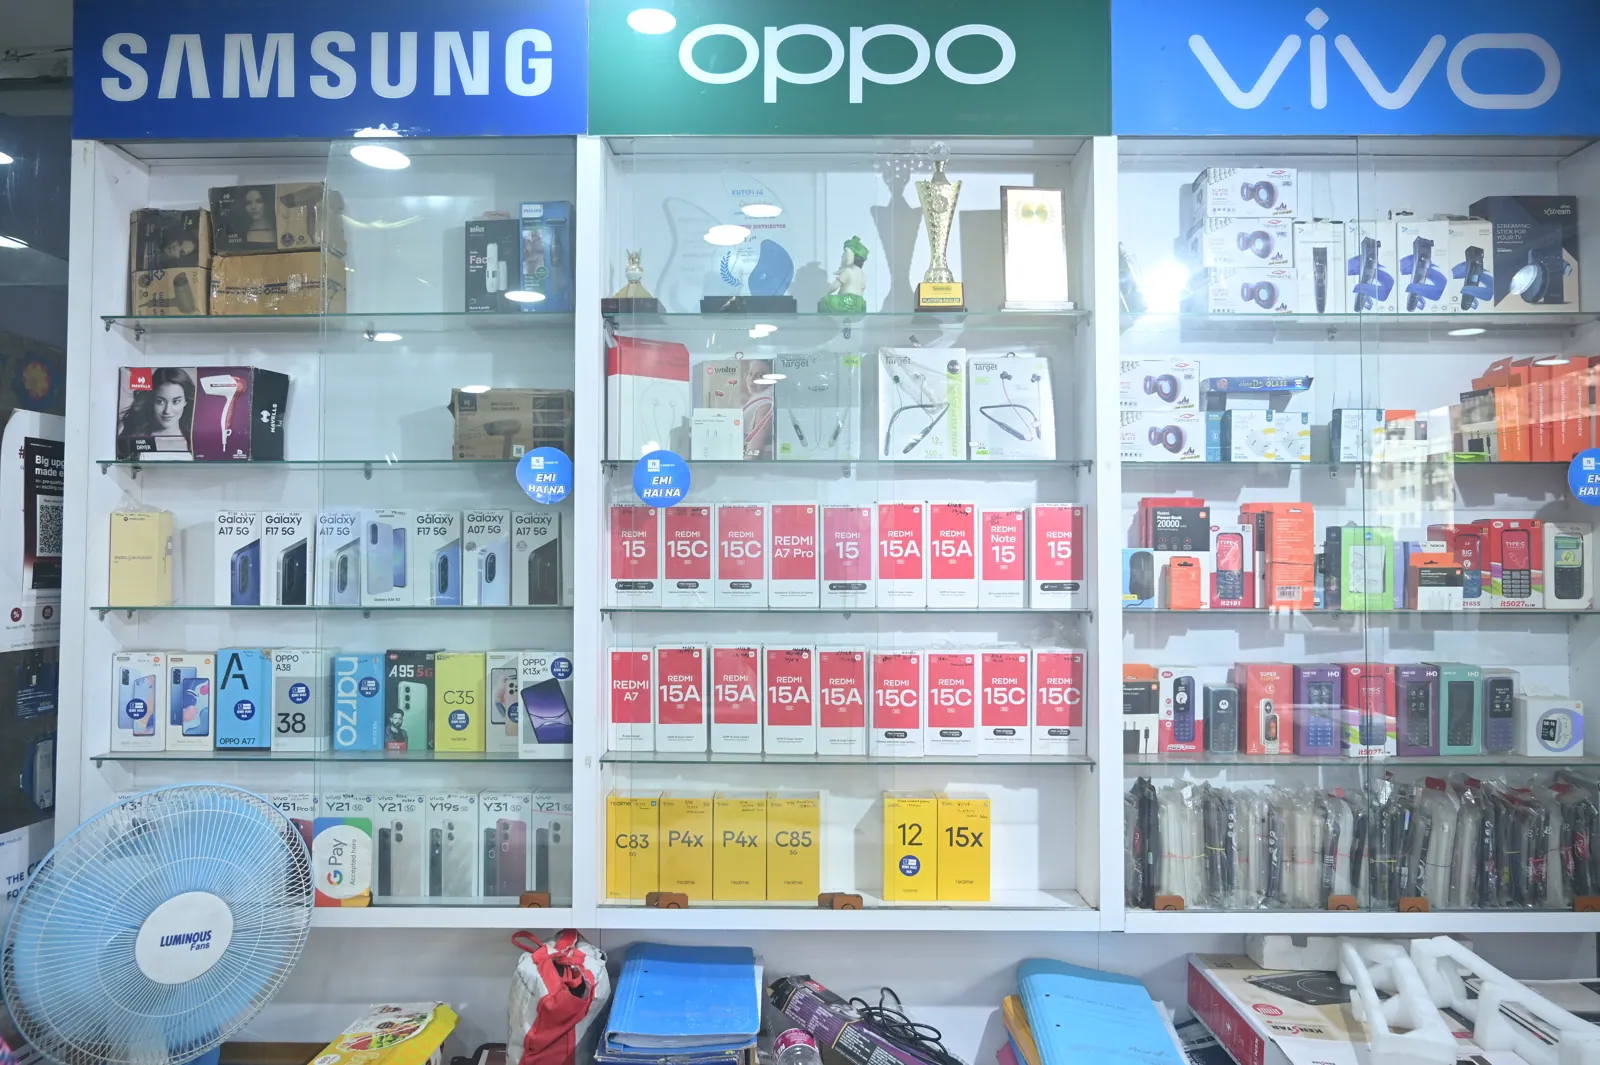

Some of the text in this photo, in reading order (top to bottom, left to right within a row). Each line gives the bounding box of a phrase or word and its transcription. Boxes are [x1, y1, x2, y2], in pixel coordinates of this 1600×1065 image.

[679, 23, 1017, 104] oppo
[1188, 7, 1561, 110] vivo
[101, 29, 553, 102] SAMSUNG
[781, 359, 809, 369] Target
[974, 363, 998, 373] Target
[270, 403, 278, 433] HAVELLS
[35, 455, 49, 467] Big
[35, 467, 58, 476] made
[536, 474, 556, 482] EMI
[652, 476, 672, 485] EMI
[528, 484, 565, 494] HAI NA
[643, 488, 681, 498] HAI NA
[1579, 487, 1598, 496] HAI
[218, 515, 255, 525] Galaxy
[265, 515, 302, 526] Galaxy
[320, 515, 356, 526] Galaxy
[416, 515, 454, 526] Galaxy
[467, 514, 504, 524] Galaxy
[515, 515, 552, 526] Galaxy
[1156, 520, 1180, 528] 20000
[218, 527, 250, 536] A17 5G
[265, 527, 295, 536] F17 5G
[320, 527, 350, 536] A17 5G
[417, 527, 447, 536] F17 5G
[467, 526, 501, 534] A07 5G
[515, 527, 548, 536] A17 5G
[622, 530, 647, 538] REDMI
[675, 530, 700, 538] REDMI
[888, 530, 913, 538] REDMI
[940, 530, 965, 538] REDMI
[774, 536, 813, 546] REDMI
[990, 534, 1016, 543] Note
[622, 540, 646, 558] 15
[667, 540, 708, 558] 15C
[720, 540, 762, 558] 15C
[774, 548, 814, 558] A7 Pro
[835, 542, 860, 558] 15
[880, 540, 921, 558] 15A
[932, 540, 973, 558] 15A
[1047, 541, 1072, 559] 15
[992, 546, 1016, 564] 15
[1500, 600, 1525, 608] it5027
[276, 654, 298, 662] OPPO
[522, 658, 546, 667] OPPO
[220, 652, 249, 690] A
[276, 664, 292, 672] A38
[388, 664, 414, 678] A95
[522, 666, 541, 676] K13x
[723, 674, 748, 682] REDMI
[776, 676, 802, 684] REDMI
[883, 679, 910, 687] REDMI
[938, 678, 964, 686] REDMI
[992, 677, 1018, 685] REDMI
[1046, 677, 1073, 685] REDMI
[614, 680, 649, 689] REDMI
[443, 690, 474, 705] C35
[624, 692, 638, 701] A7
[660, 684, 700, 702] 15A
[715, 684, 756, 702] 15A
[768, 686, 810, 704] 15A
[821, 688, 863, 706] 15A
[876, 689, 917, 707] 15C
[930, 688, 972, 706] 15C
[984, 688, 1026, 705] 15C
[1039, 688, 1080, 705] 15C
[337, 656, 358, 746] narzo
[276, 713, 306, 734] 38
[274, 802, 296, 812] Y51
[326, 802, 350, 811] Y21
[378, 802, 402, 812] Y21
[429, 802, 460, 812] Y19s
[483, 802, 508, 812] Y31
[536, 802, 561, 812] Y21
[668, 830, 704, 848] P4x
[722, 830, 758, 848] P4x
[775, 831, 812, 848] C85
[898, 824, 922, 846] 12
[945, 826, 984, 848] 15x
[616, 834, 650, 849] C83
[328, 838, 347, 866] Pay
[6, 872, 24, 886] THE
[160, 930, 212, 948] LUMINOUS
[190, 942, 210, 952] Fans
[1271, 1024, 1323, 1035] KENSTAR
